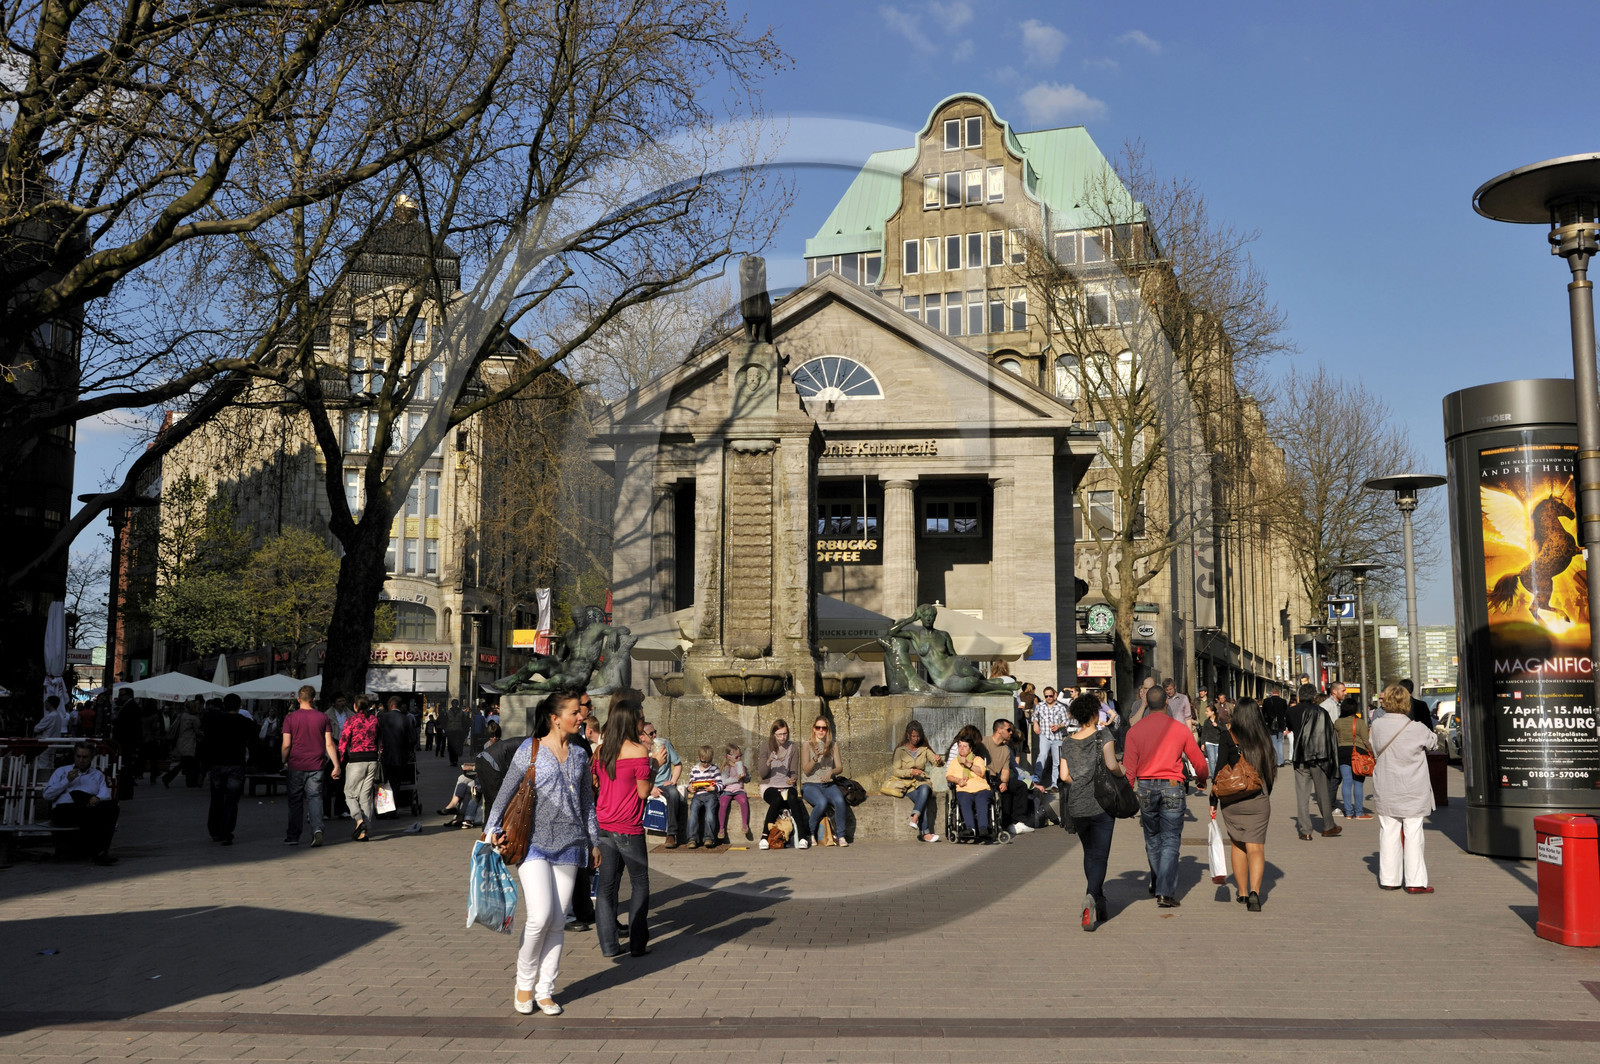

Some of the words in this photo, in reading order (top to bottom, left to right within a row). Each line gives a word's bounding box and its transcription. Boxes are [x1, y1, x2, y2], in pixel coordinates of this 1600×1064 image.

[393, 650, 452, 662] CIGARREN
[1503, 706, 1513, 715] 7.
[1514, 705, 1545, 717] April
[1554, 706, 1572, 714] 15.
[1573, 705, 1593, 715] Mai
[1512, 717, 1596, 729] HAMBURG
